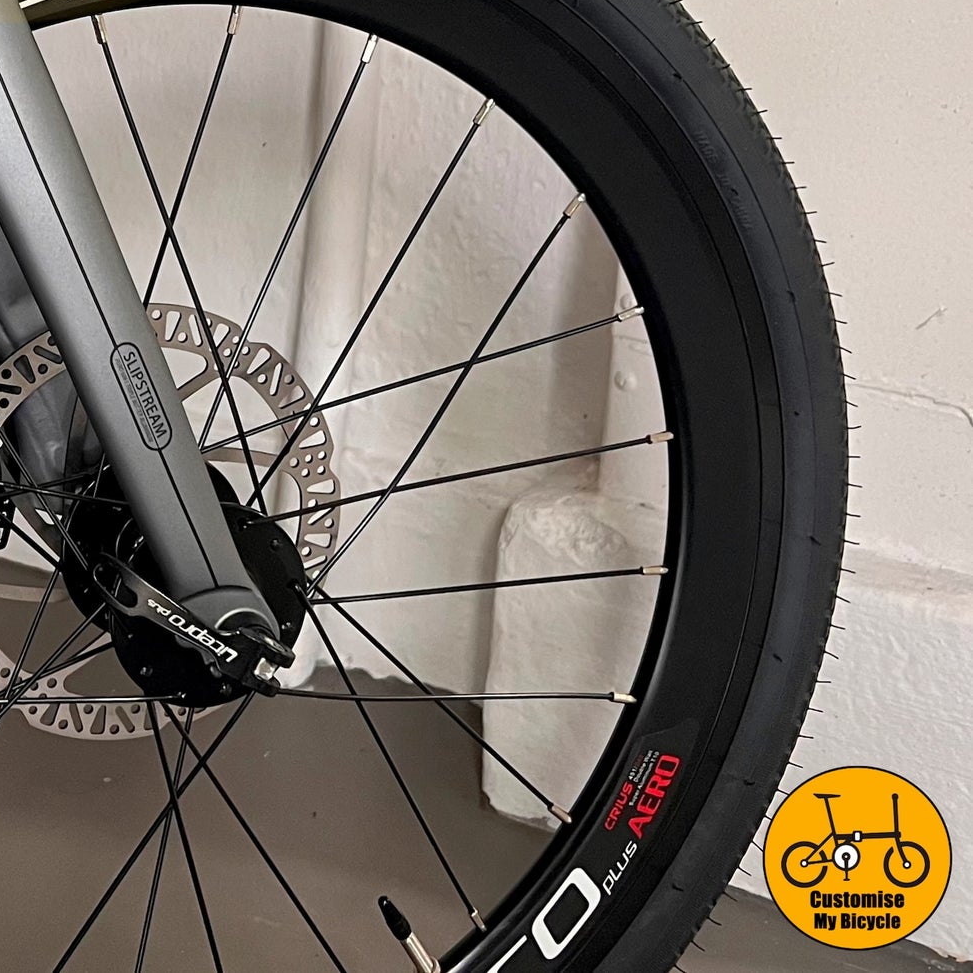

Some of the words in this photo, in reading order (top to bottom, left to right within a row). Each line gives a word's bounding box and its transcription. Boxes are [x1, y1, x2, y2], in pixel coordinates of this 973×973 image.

[122, 351, 168, 438] SLIPSTREAM
[604, 781, 633, 831] CRIUS
[628, 754, 681, 840] AERO
